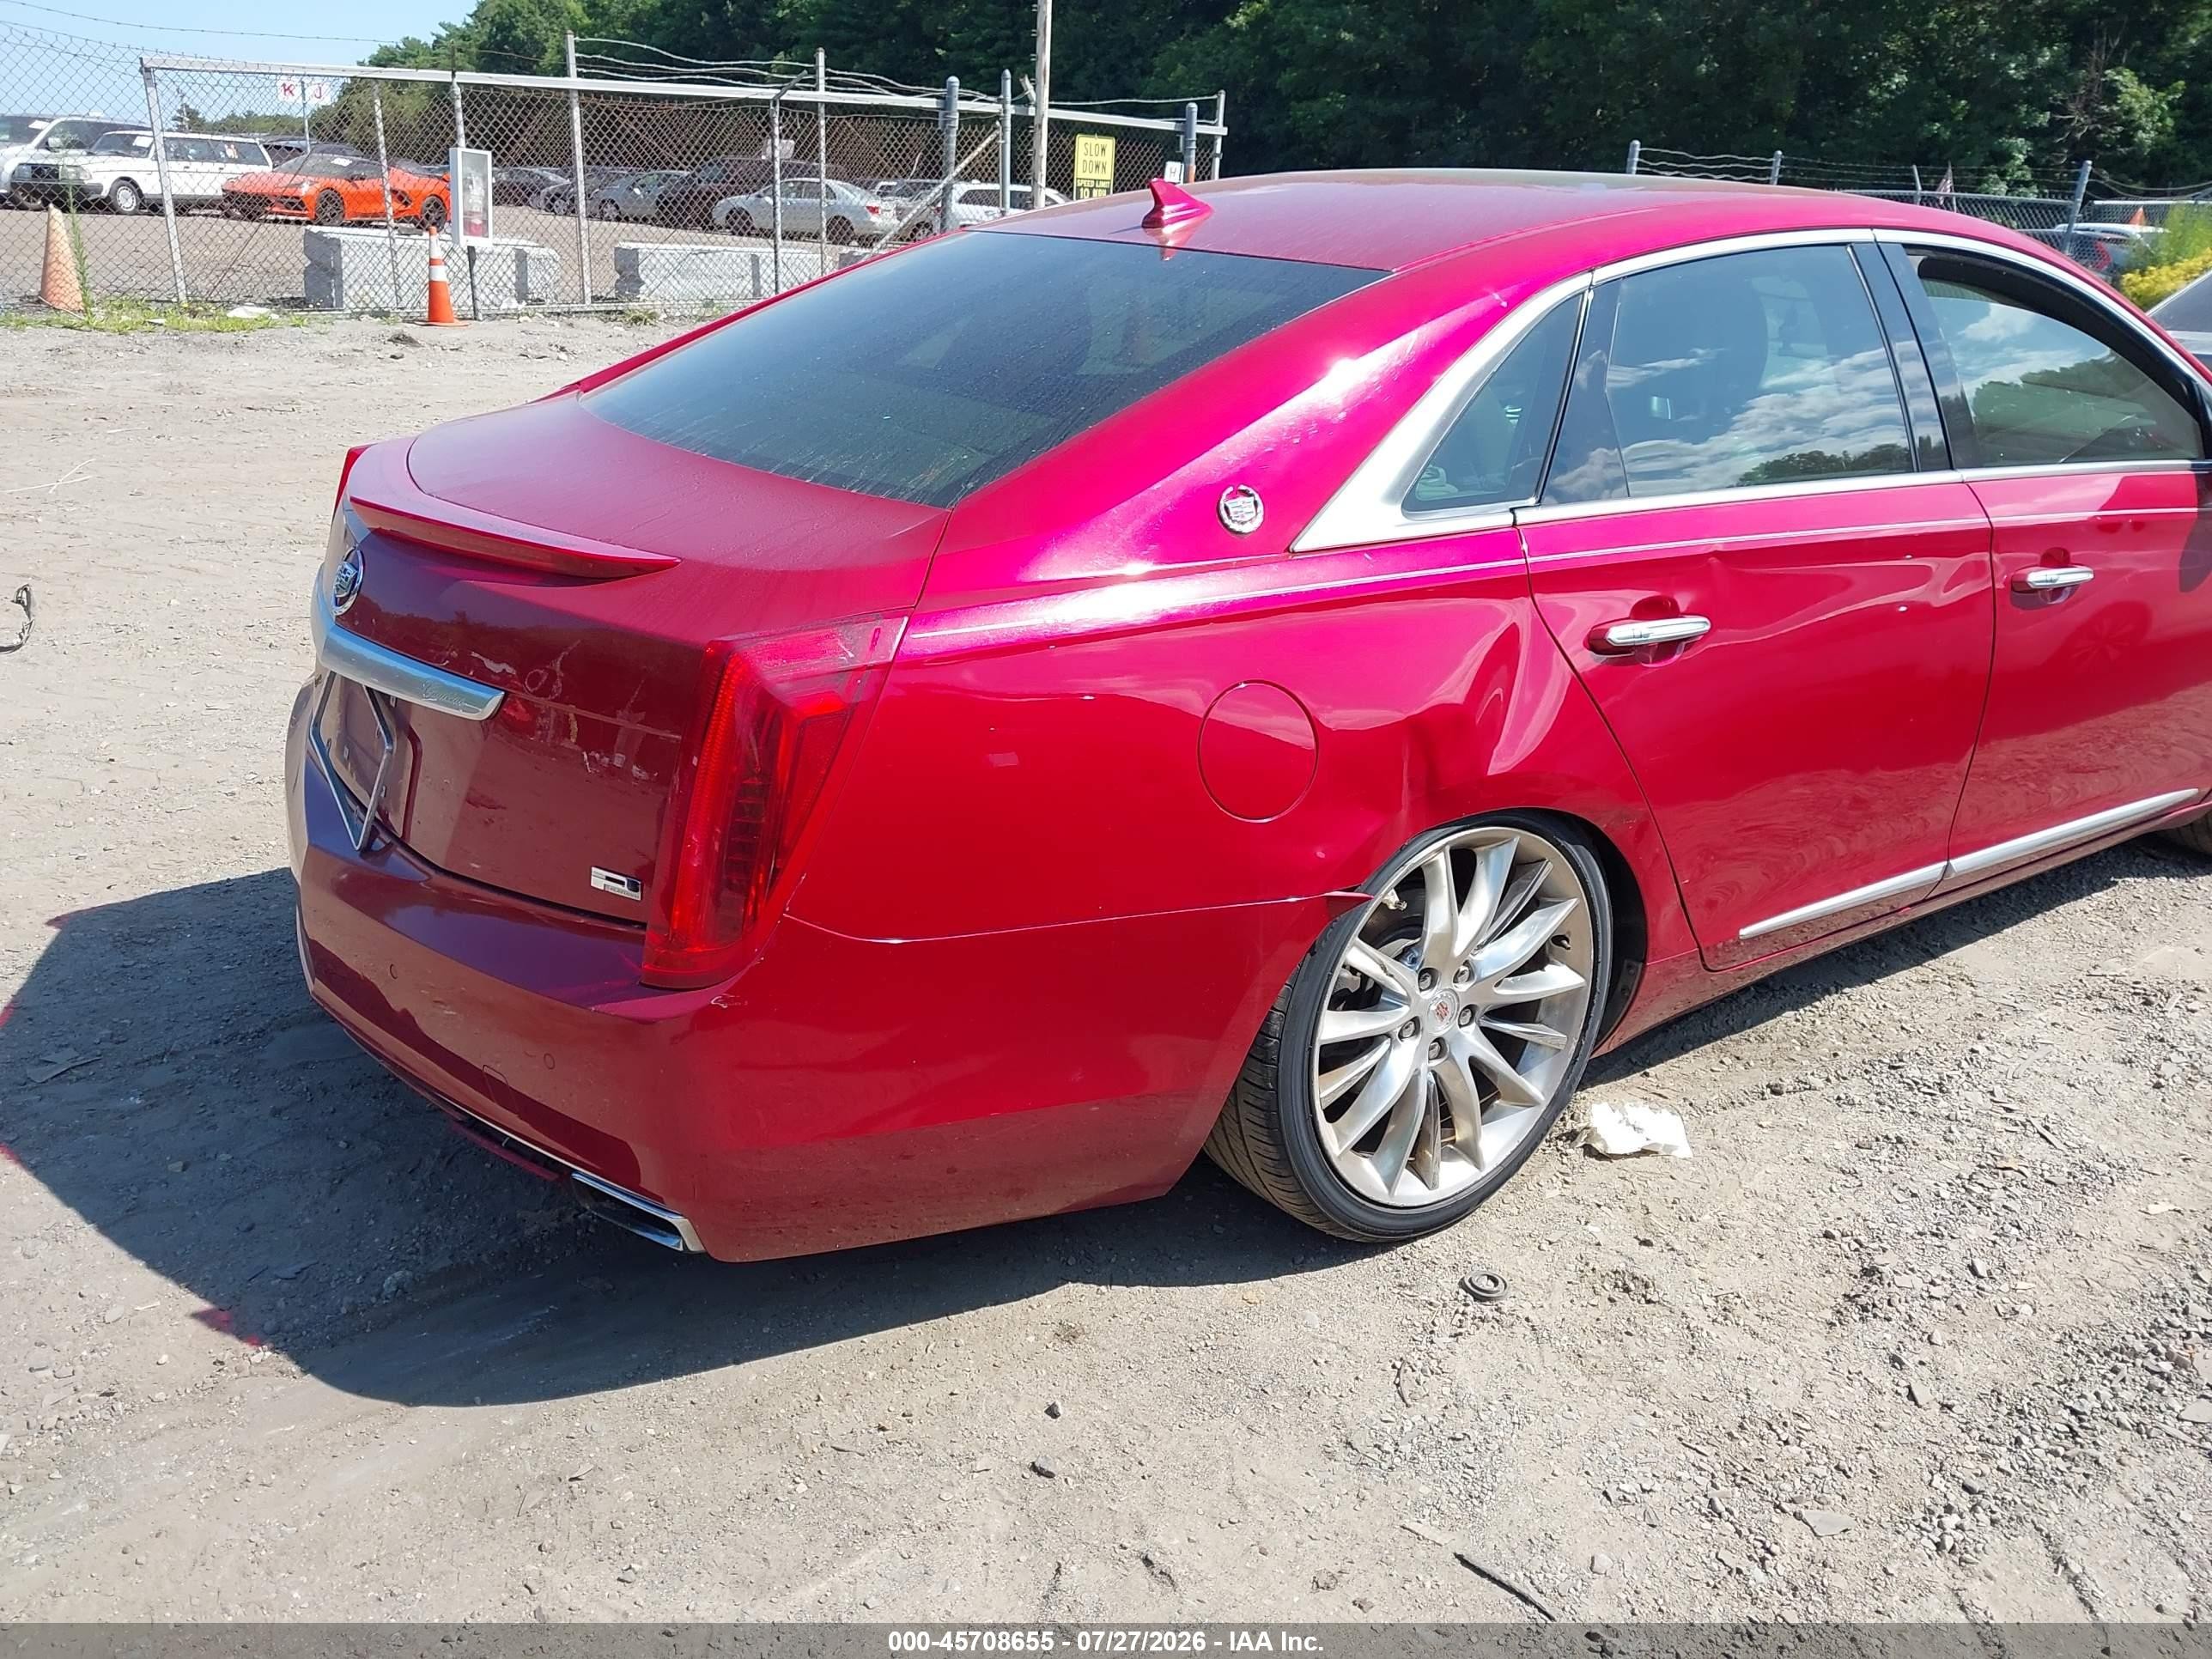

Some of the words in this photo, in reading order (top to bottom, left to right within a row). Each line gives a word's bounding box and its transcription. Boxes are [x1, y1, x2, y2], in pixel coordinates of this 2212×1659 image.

[1084, 142, 1107, 157] SLOW
[1082, 159, 1107, 174] DOWN
[1169, 166, 1177, 179] H
[1076, 179, 1095, 188] SPEED
[1095, 179, 1110, 189] LIMIT
[1079, 186, 1091, 199] 10
